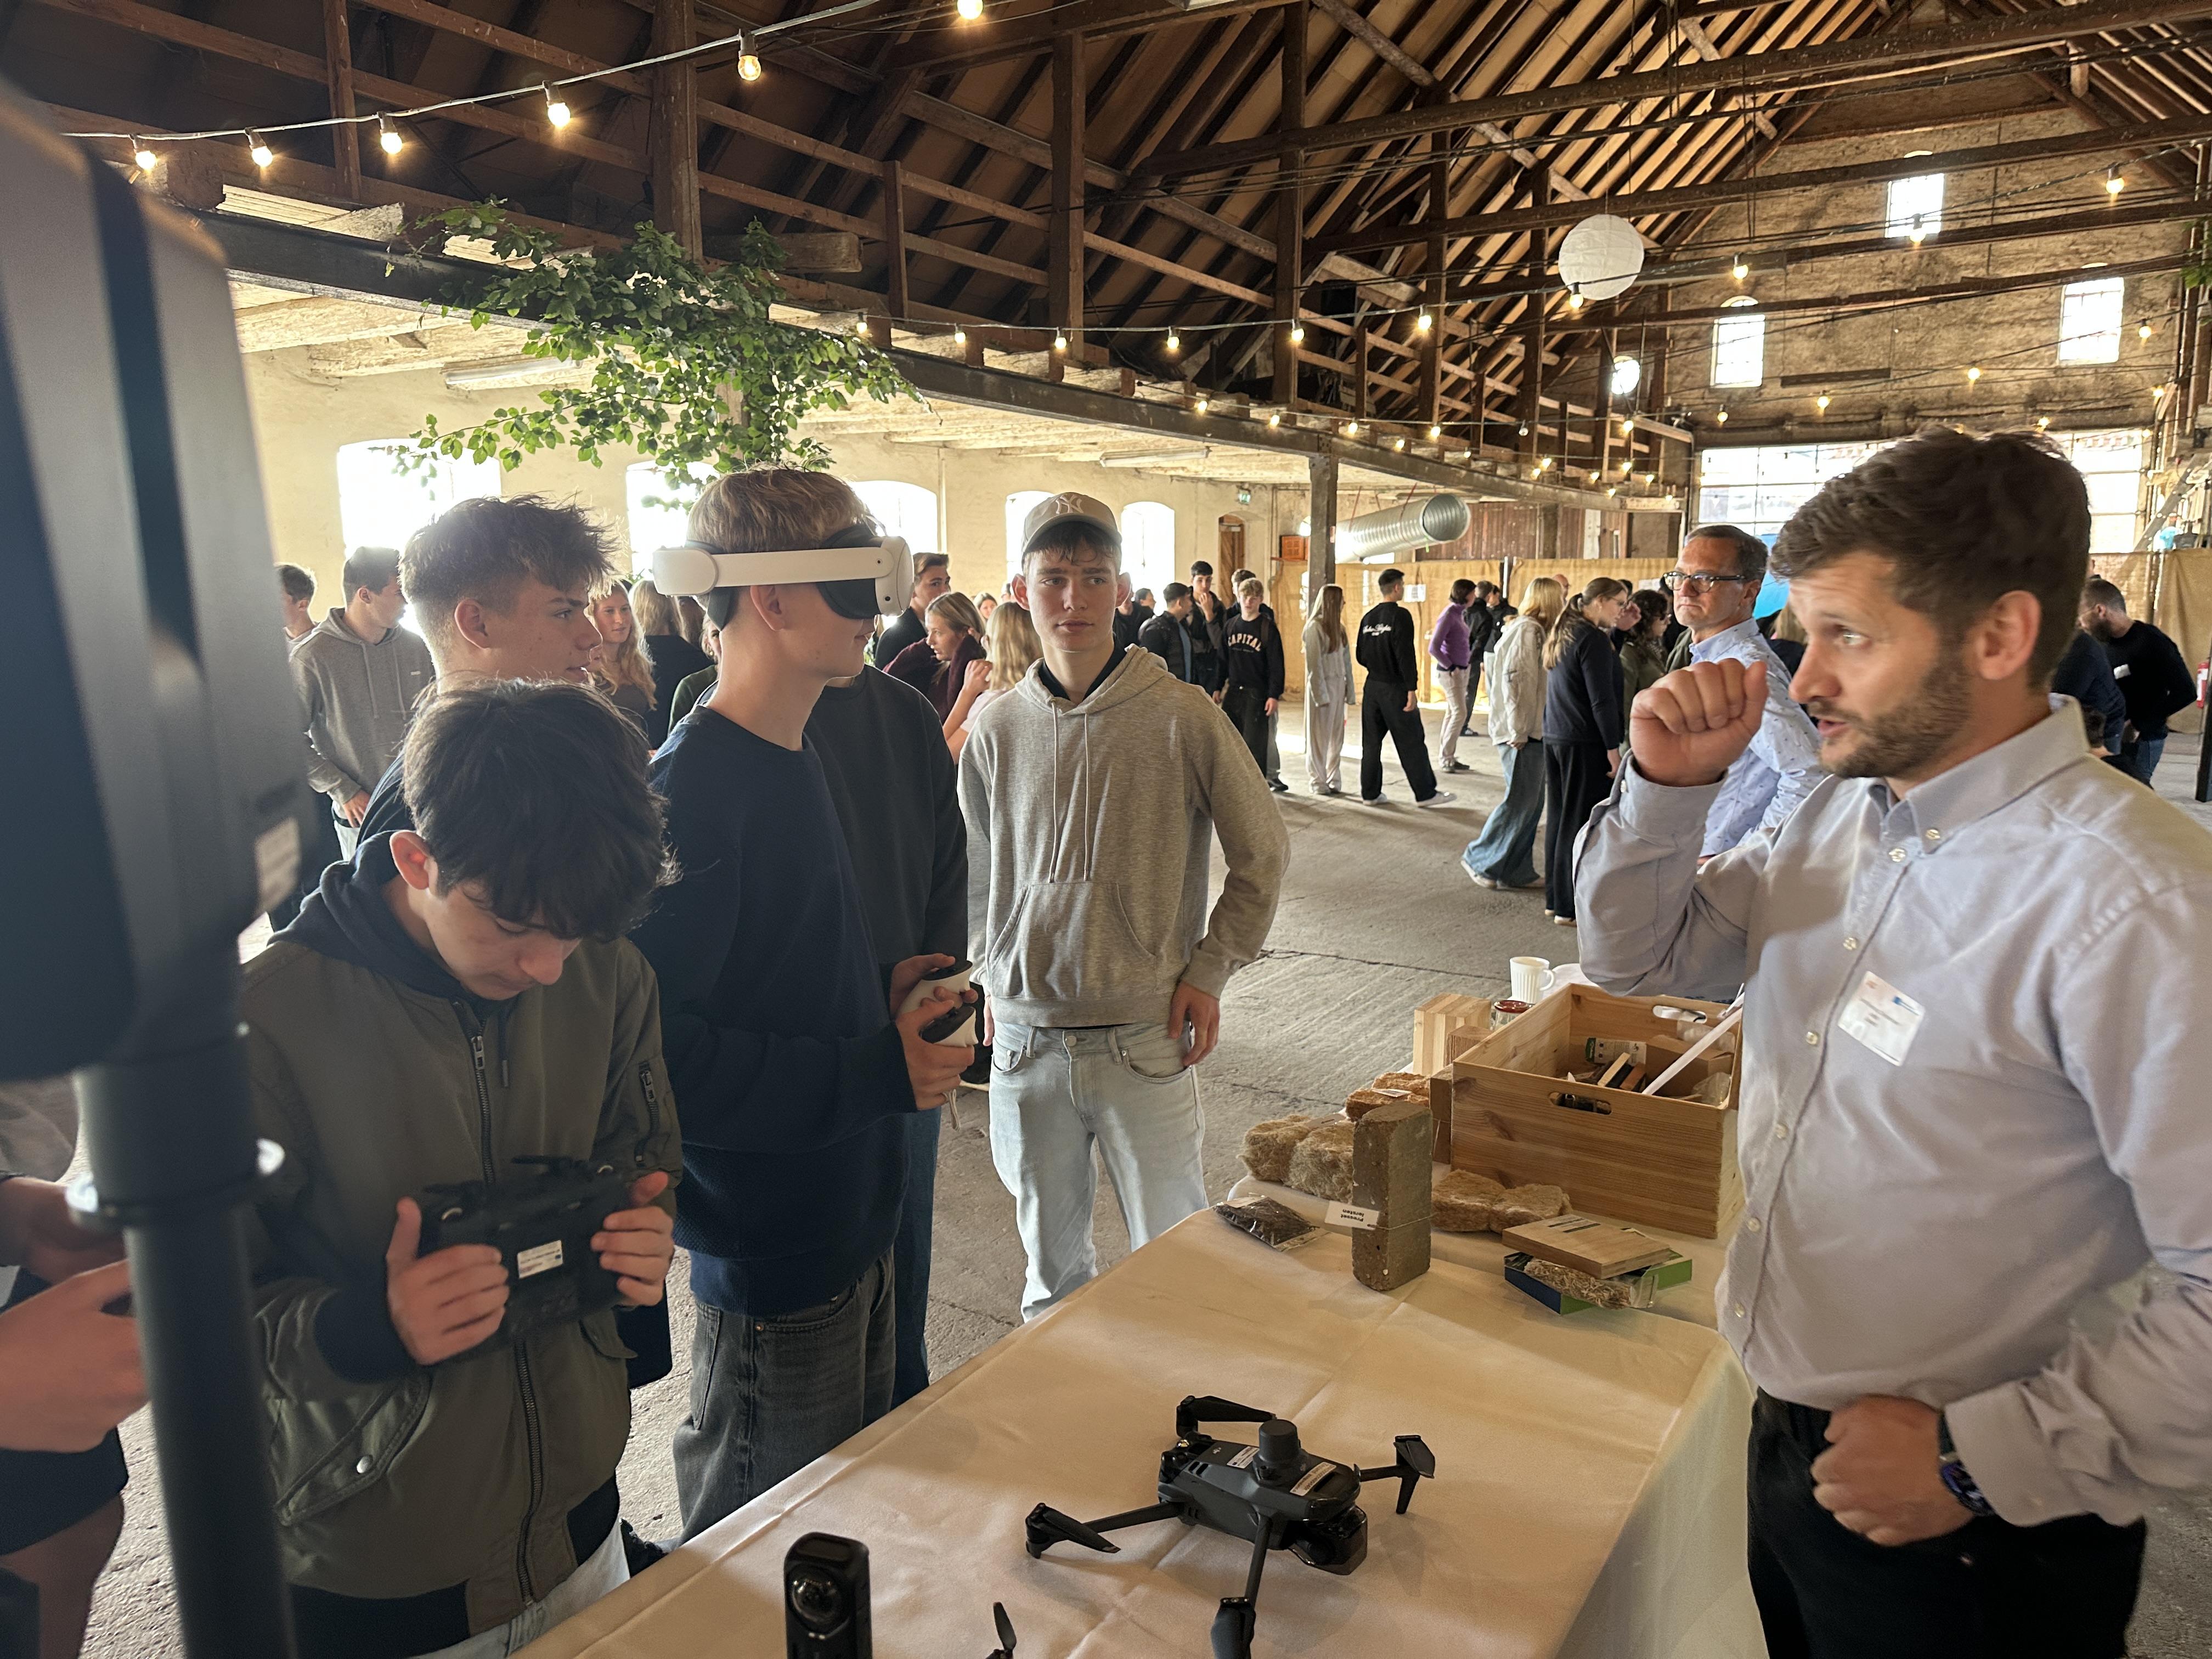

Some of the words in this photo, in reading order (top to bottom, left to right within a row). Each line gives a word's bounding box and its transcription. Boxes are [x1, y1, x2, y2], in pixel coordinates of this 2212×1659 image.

[1055, 494, 1084, 515] NY
[1228, 634, 1262, 652] CAPITAL
[1340, 1214, 1364, 1222] Presset
